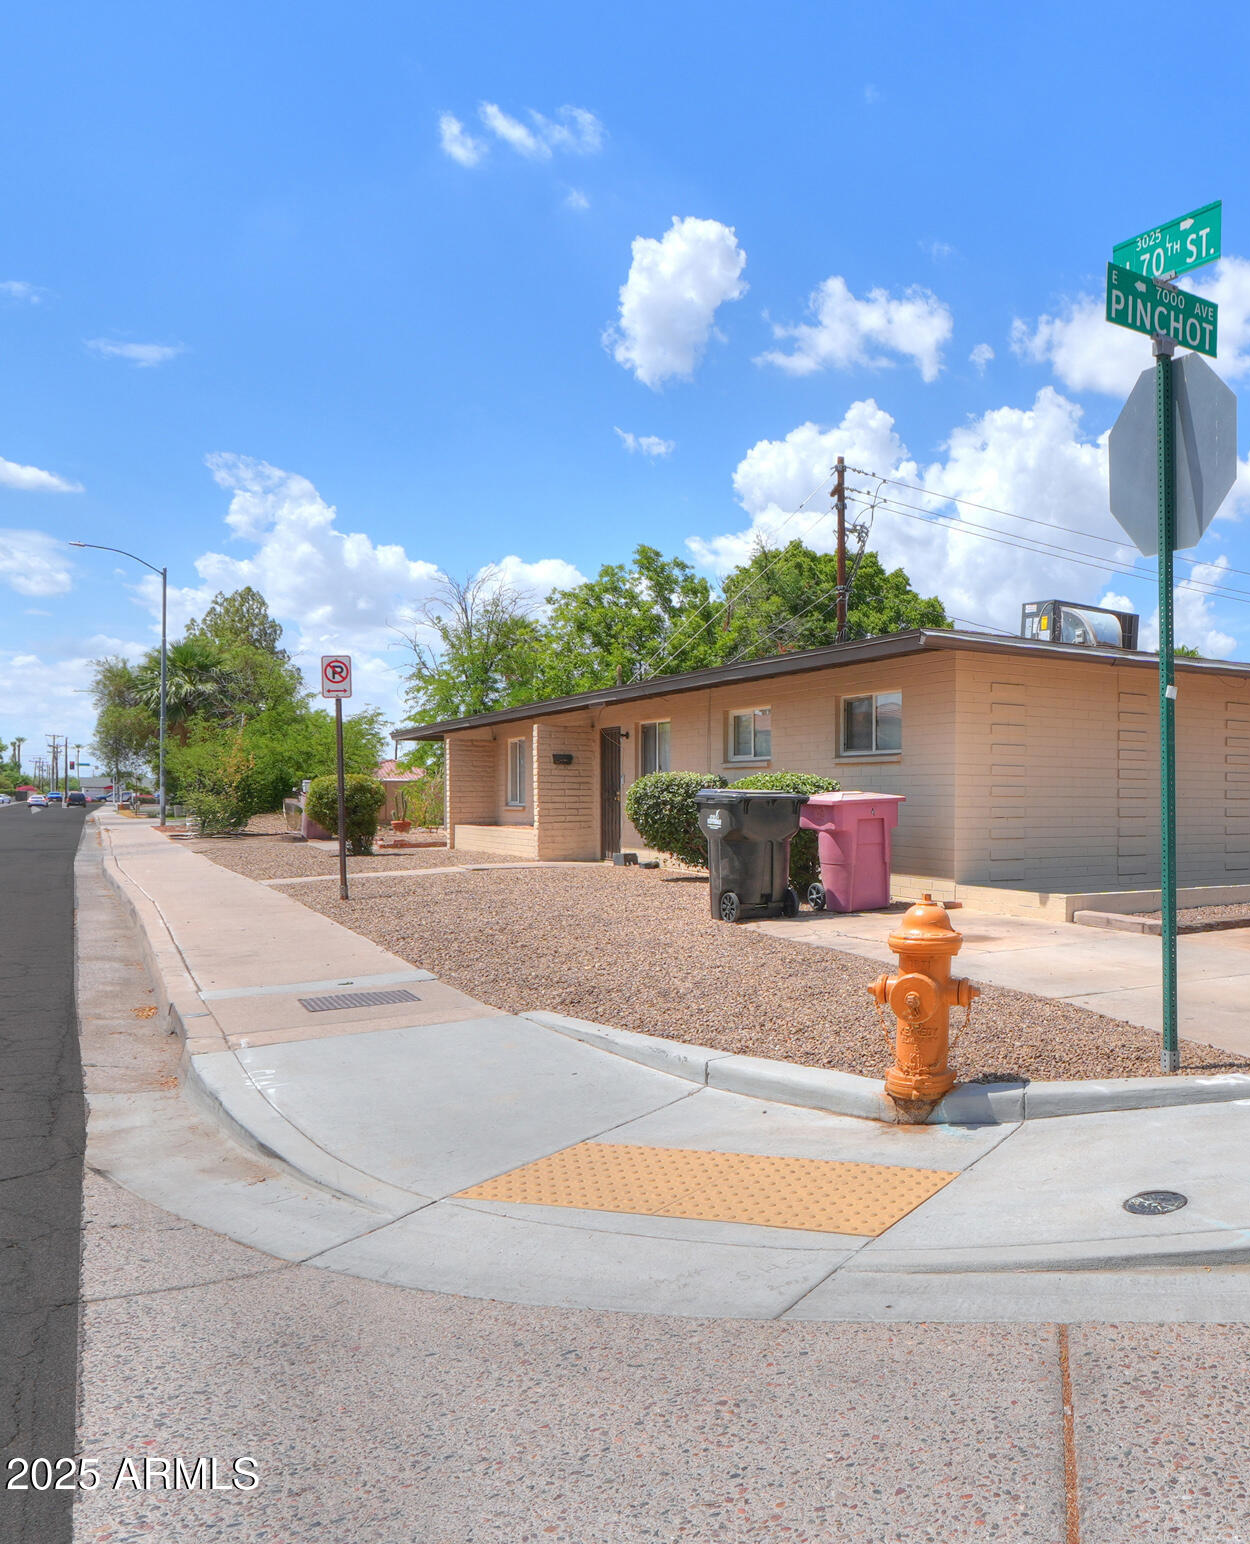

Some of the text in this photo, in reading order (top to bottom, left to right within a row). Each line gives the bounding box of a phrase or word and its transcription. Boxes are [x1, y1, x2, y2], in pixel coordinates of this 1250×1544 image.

[1136, 229, 1162, 251] 3025
[1186, 227, 1215, 263] ST.
[1112, 270, 1118, 285] E
[1155, 286, 1214, 321] 7000 AVE
[1111, 289, 1213, 351] PINCHOT
[332, 665, 344, 680] P
